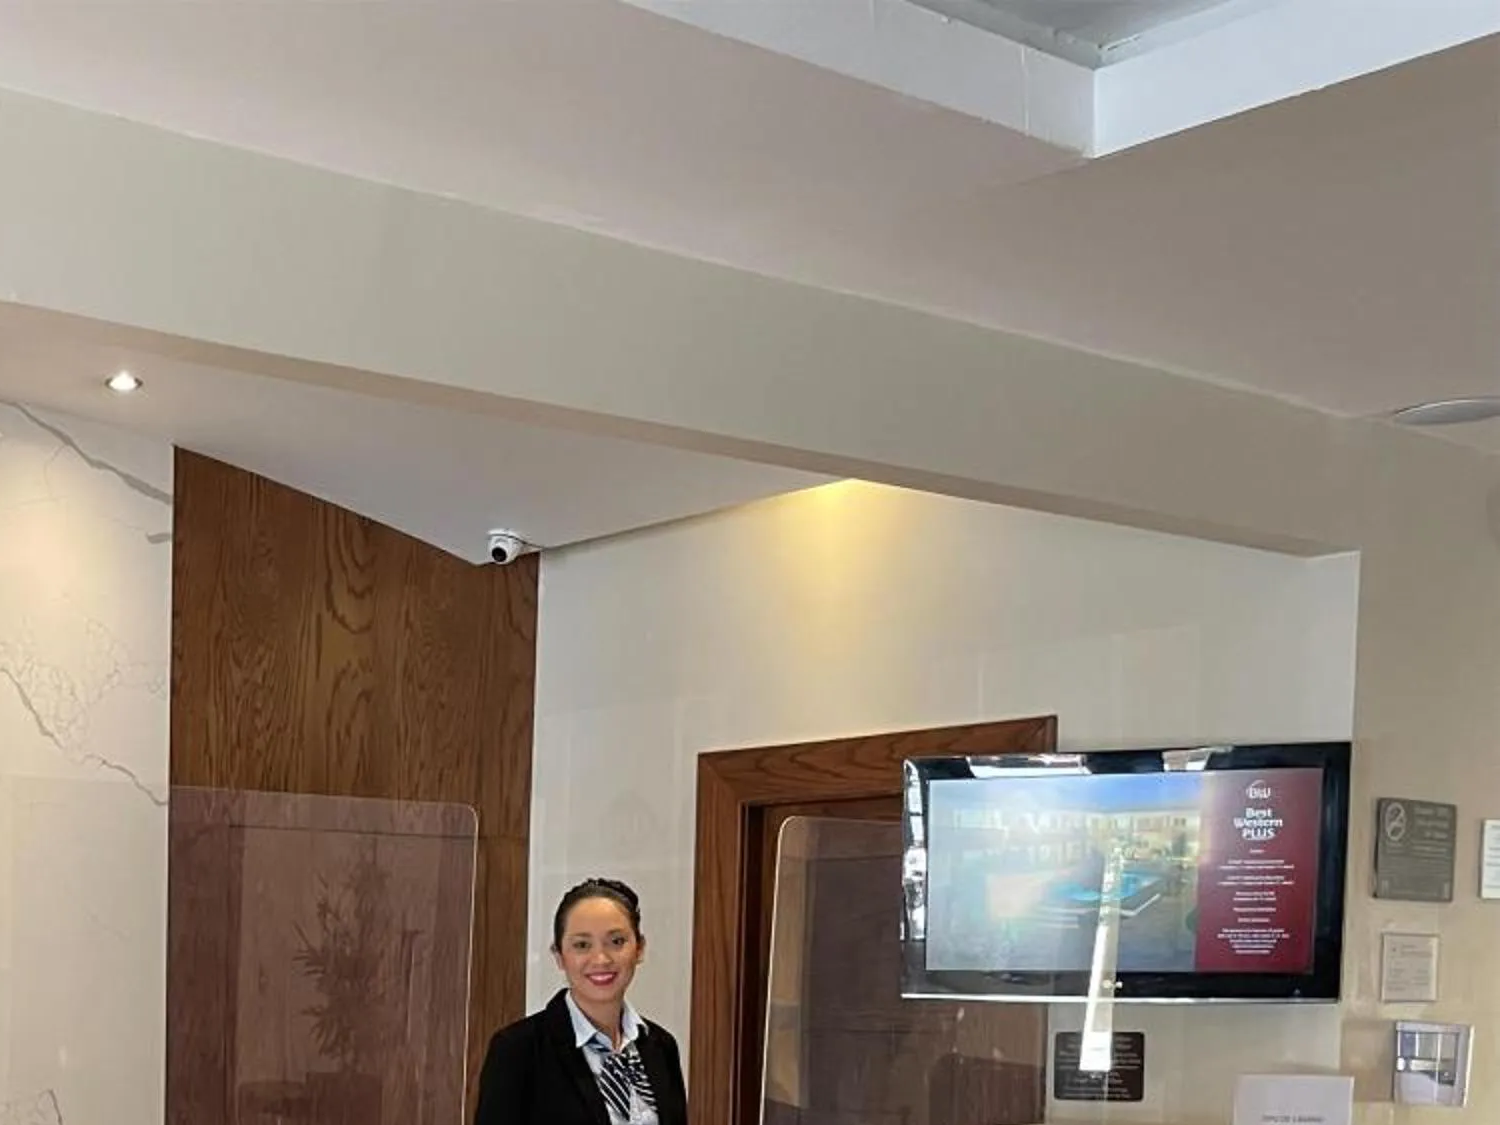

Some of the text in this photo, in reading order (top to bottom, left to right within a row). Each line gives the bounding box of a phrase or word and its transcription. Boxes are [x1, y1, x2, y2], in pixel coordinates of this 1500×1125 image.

[1245, 807, 1273, 818] Best
[1233, 817, 1283, 829] Western
[1242, 827, 1275, 839] PLUS
